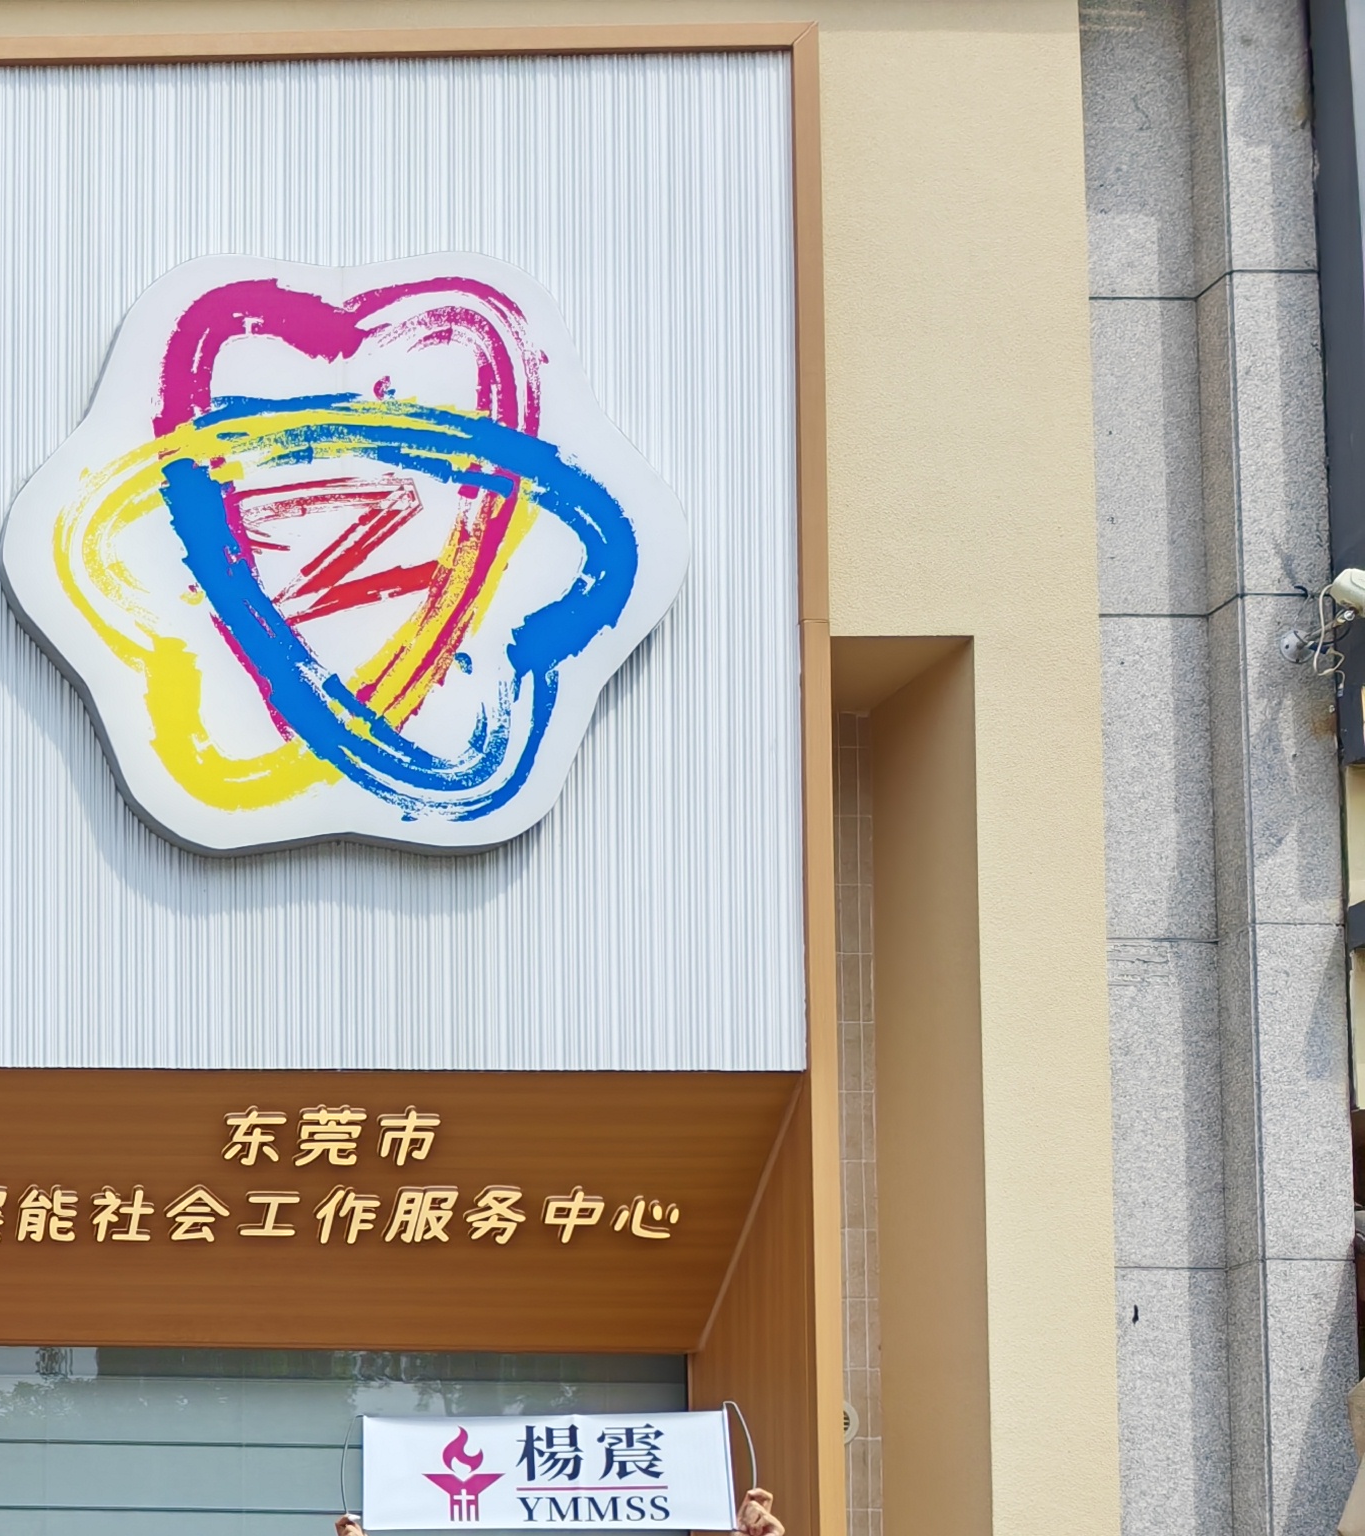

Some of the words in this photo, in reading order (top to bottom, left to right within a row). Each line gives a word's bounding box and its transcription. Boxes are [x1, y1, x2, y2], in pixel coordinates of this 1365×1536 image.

[222, 1105, 443, 1167] 东莞市
[515, 1423, 665, 1482] 楊震
[517, 1495, 670, 1523] YMMSS
